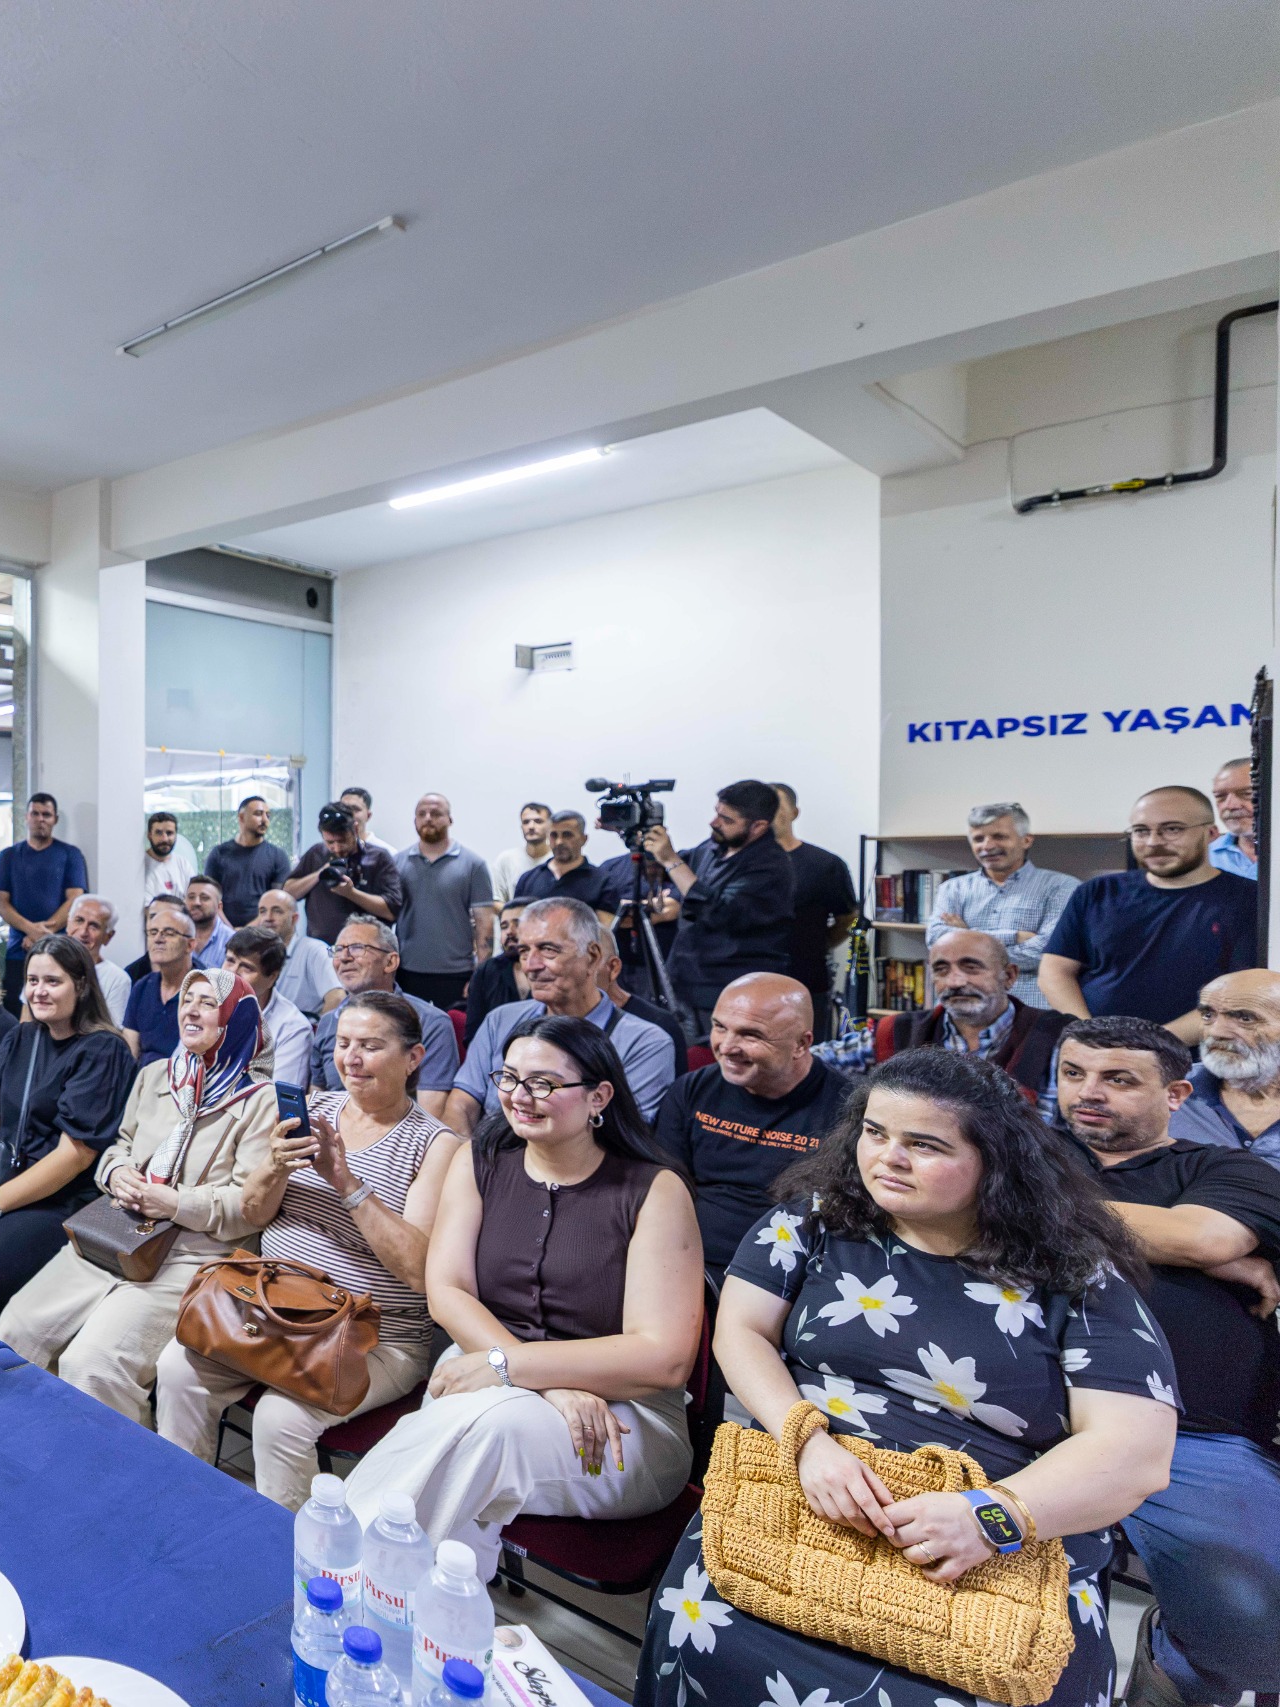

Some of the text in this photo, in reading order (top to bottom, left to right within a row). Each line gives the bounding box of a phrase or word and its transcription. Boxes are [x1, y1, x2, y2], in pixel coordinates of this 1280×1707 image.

[907, 712, 1088, 743] KİTAPSIZ
[695, 1111, 720, 1126] NEW
[720, 1120, 760, 1138] FUTURE
[762, 1129, 793, 1143] NOISE
[794, 1134, 808, 1146] 20
[365, 1573, 405, 1608] Pirsu
